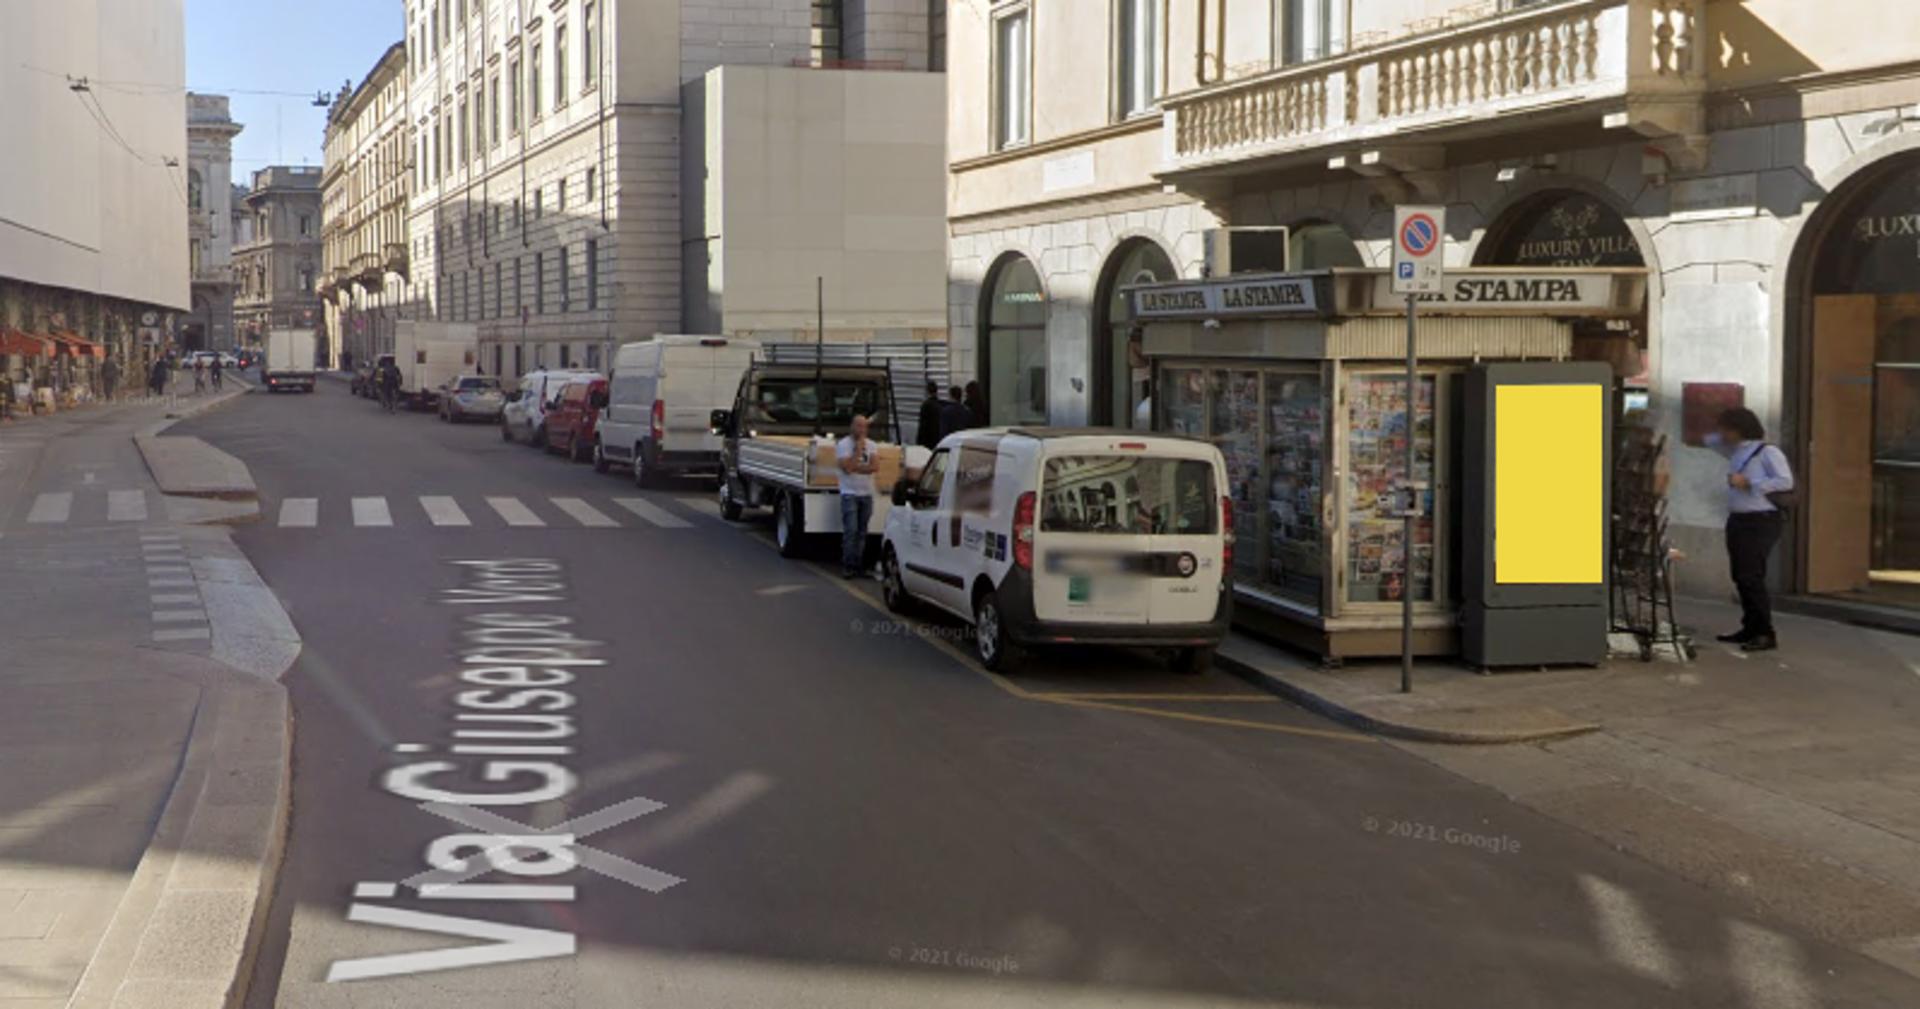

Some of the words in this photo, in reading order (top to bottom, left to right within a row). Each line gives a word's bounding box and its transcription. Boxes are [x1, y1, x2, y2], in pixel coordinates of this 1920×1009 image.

[1518, 240, 1582, 259] LUXURY
[1141, 293, 1156, 311] LA
[1158, 290, 1206, 310] STAMPA
[1223, 288, 1243, 308] LA
[1244, 283, 1305, 306] STAMPA
[1455, 279, 1581, 302] STAMPA
